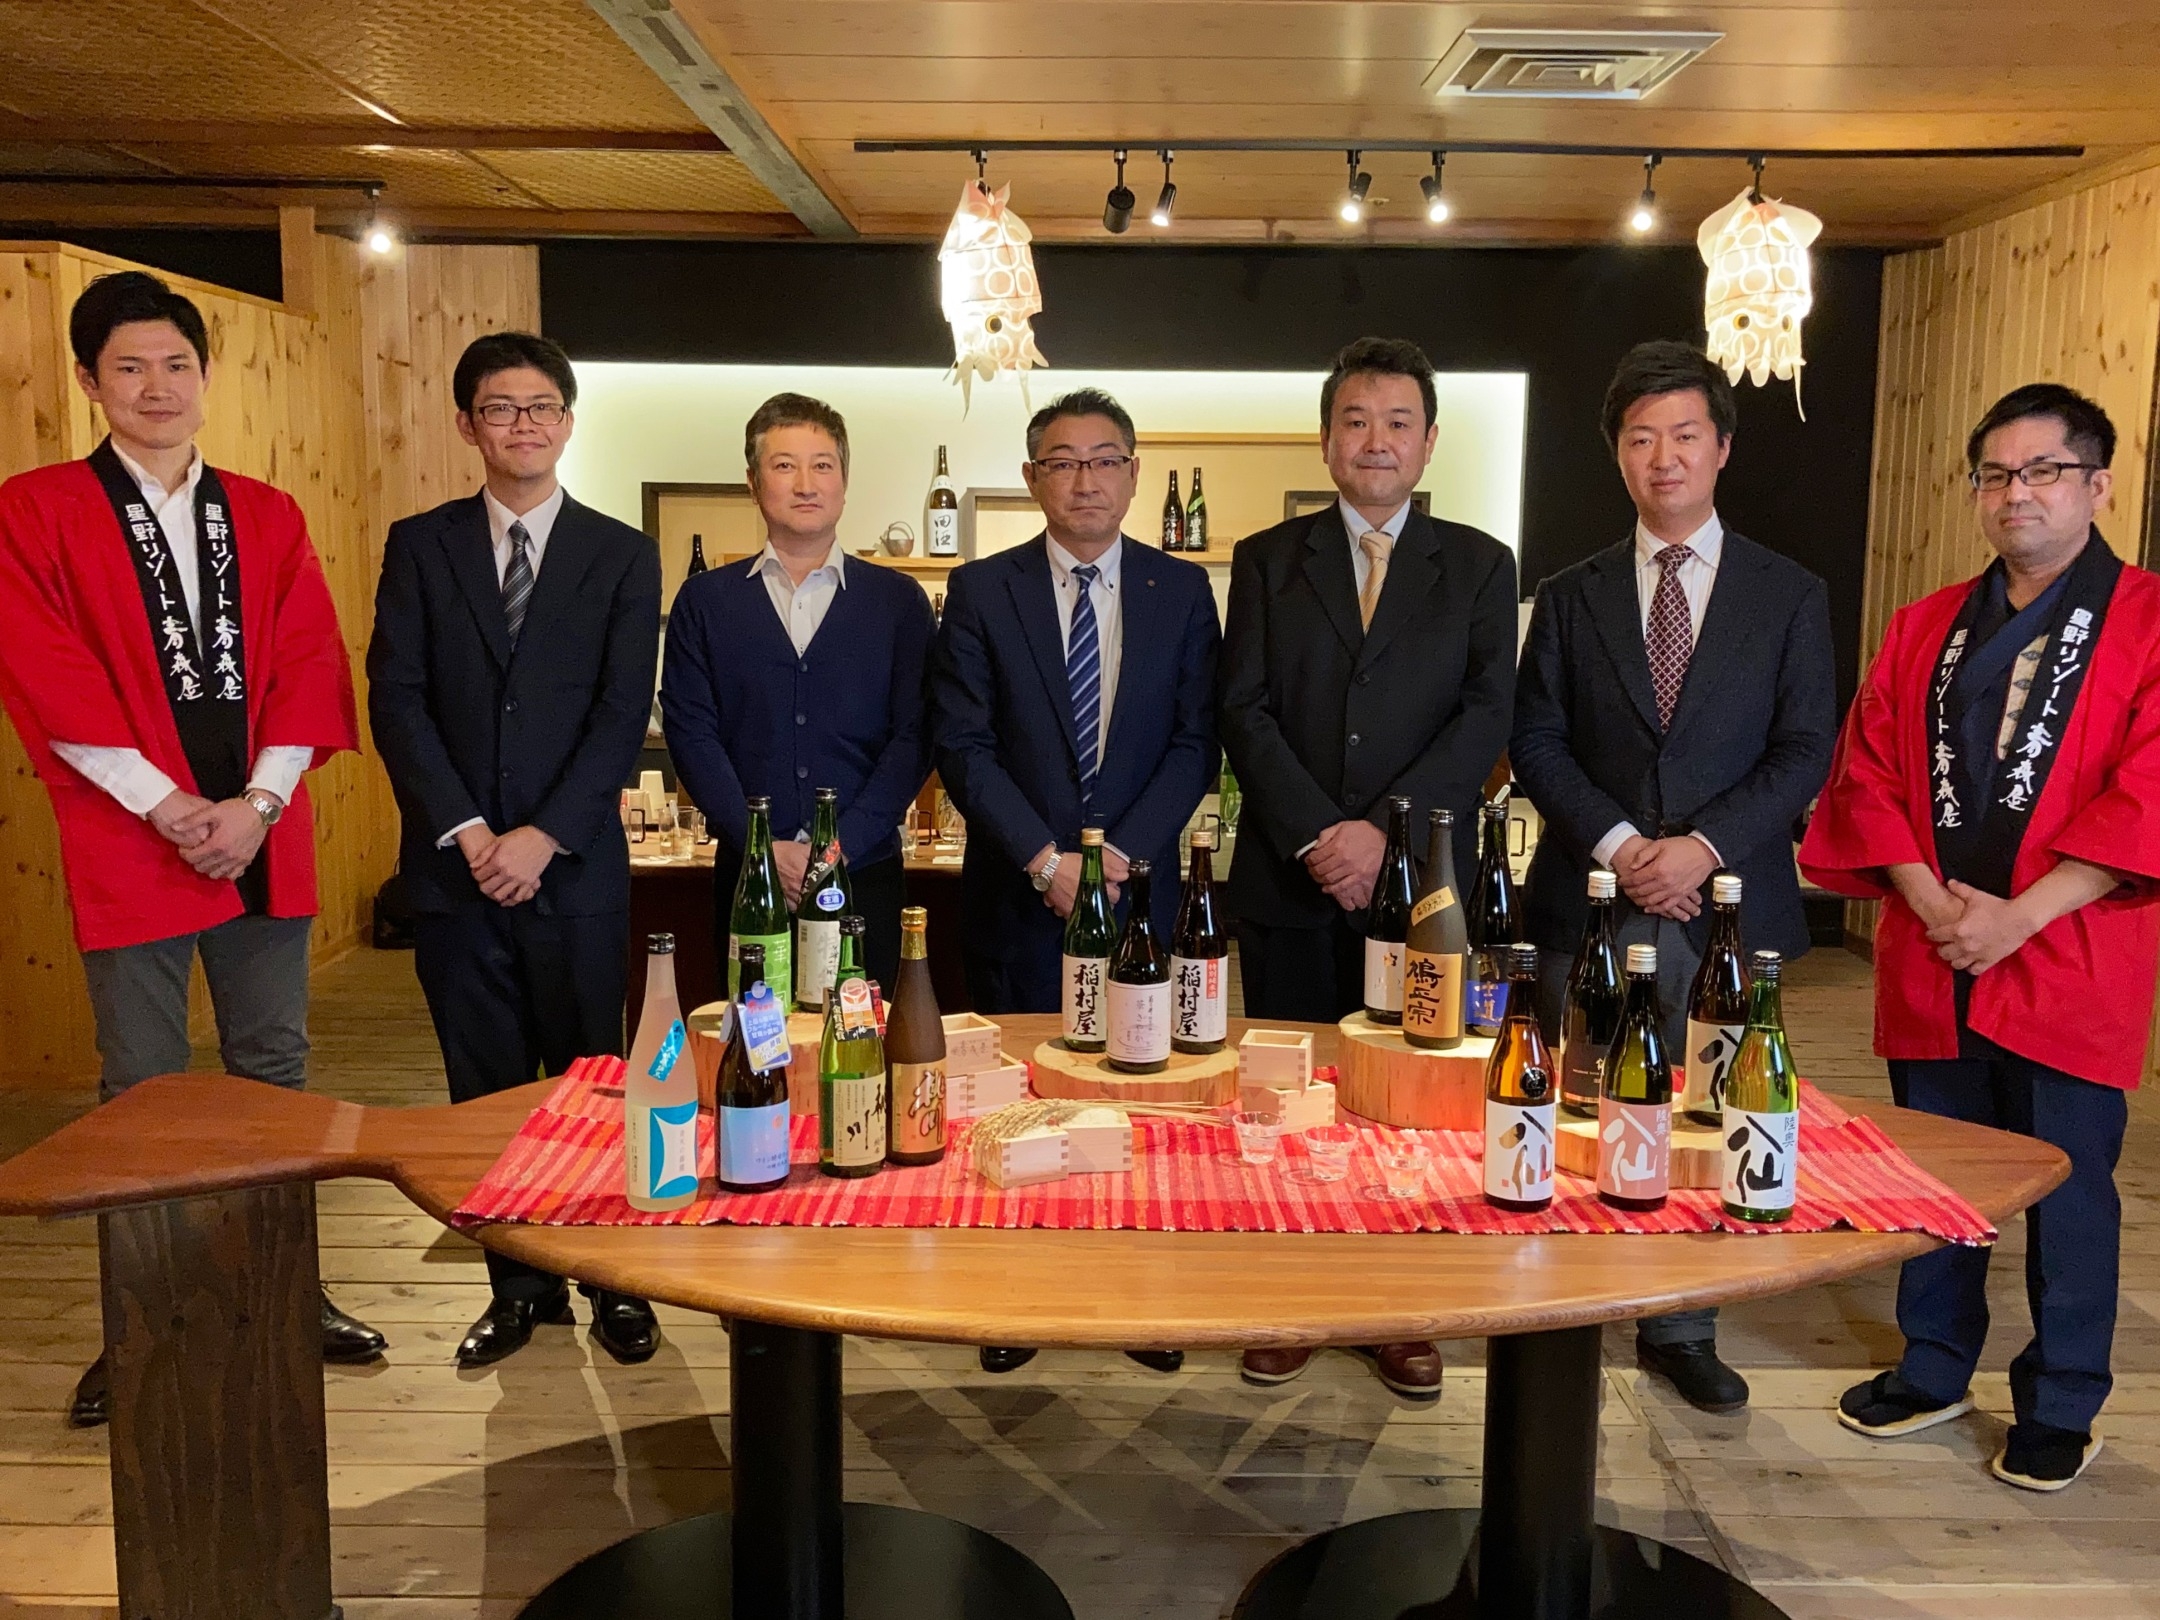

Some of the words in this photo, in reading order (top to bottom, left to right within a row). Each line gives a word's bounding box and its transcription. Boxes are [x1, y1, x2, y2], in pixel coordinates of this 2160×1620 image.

[934, 514, 951, 547] 田酒
[1072, 963, 1099, 1036] 稲村屋
[1175, 964, 1201, 1038] 稲村屋
[1406, 957, 1445, 1026] 鳩正宗
[908, 1069, 947, 1145] 桃川
[1654, 1108, 1667, 1137] 陸奥
[1782, 1116, 1796, 1148] 陸奥
